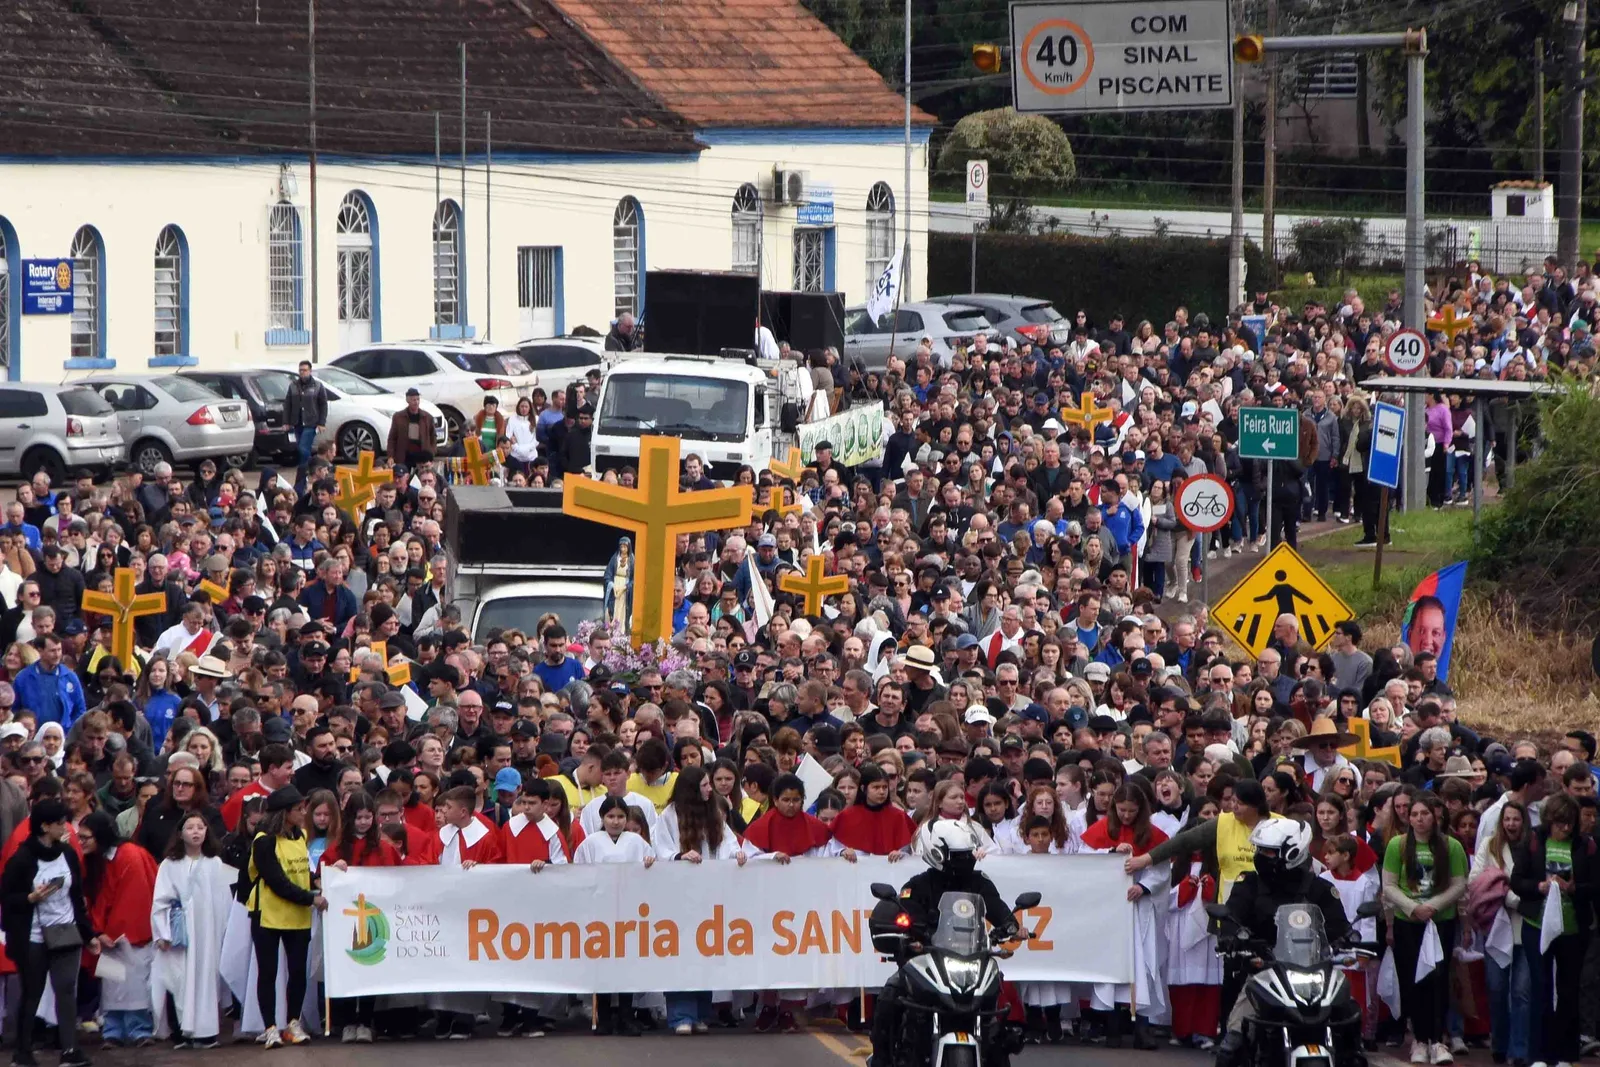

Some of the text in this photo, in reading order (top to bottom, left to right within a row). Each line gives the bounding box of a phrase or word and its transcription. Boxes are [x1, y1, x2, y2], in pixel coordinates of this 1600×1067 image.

[1131, 15, 1187, 34] COM
[1036, 35, 1078, 67] 40
[1124, 45, 1198, 64] SINAL
[1044, 72, 1073, 83] Km/h
[1099, 74, 1223, 96] PISCANTE
[974, 169, 981, 183] E
[29, 263, 56, 281] Rotary
[1394, 338, 1421, 356] 40
[1243, 413, 1294, 434] Feira Rural
[395, 910, 440, 927] SANTA
[396, 927, 441, 942] CRUZ
[468, 903, 680, 961] Romaria
[696, 905, 753, 957] da
[396, 946, 419, 958] DO
